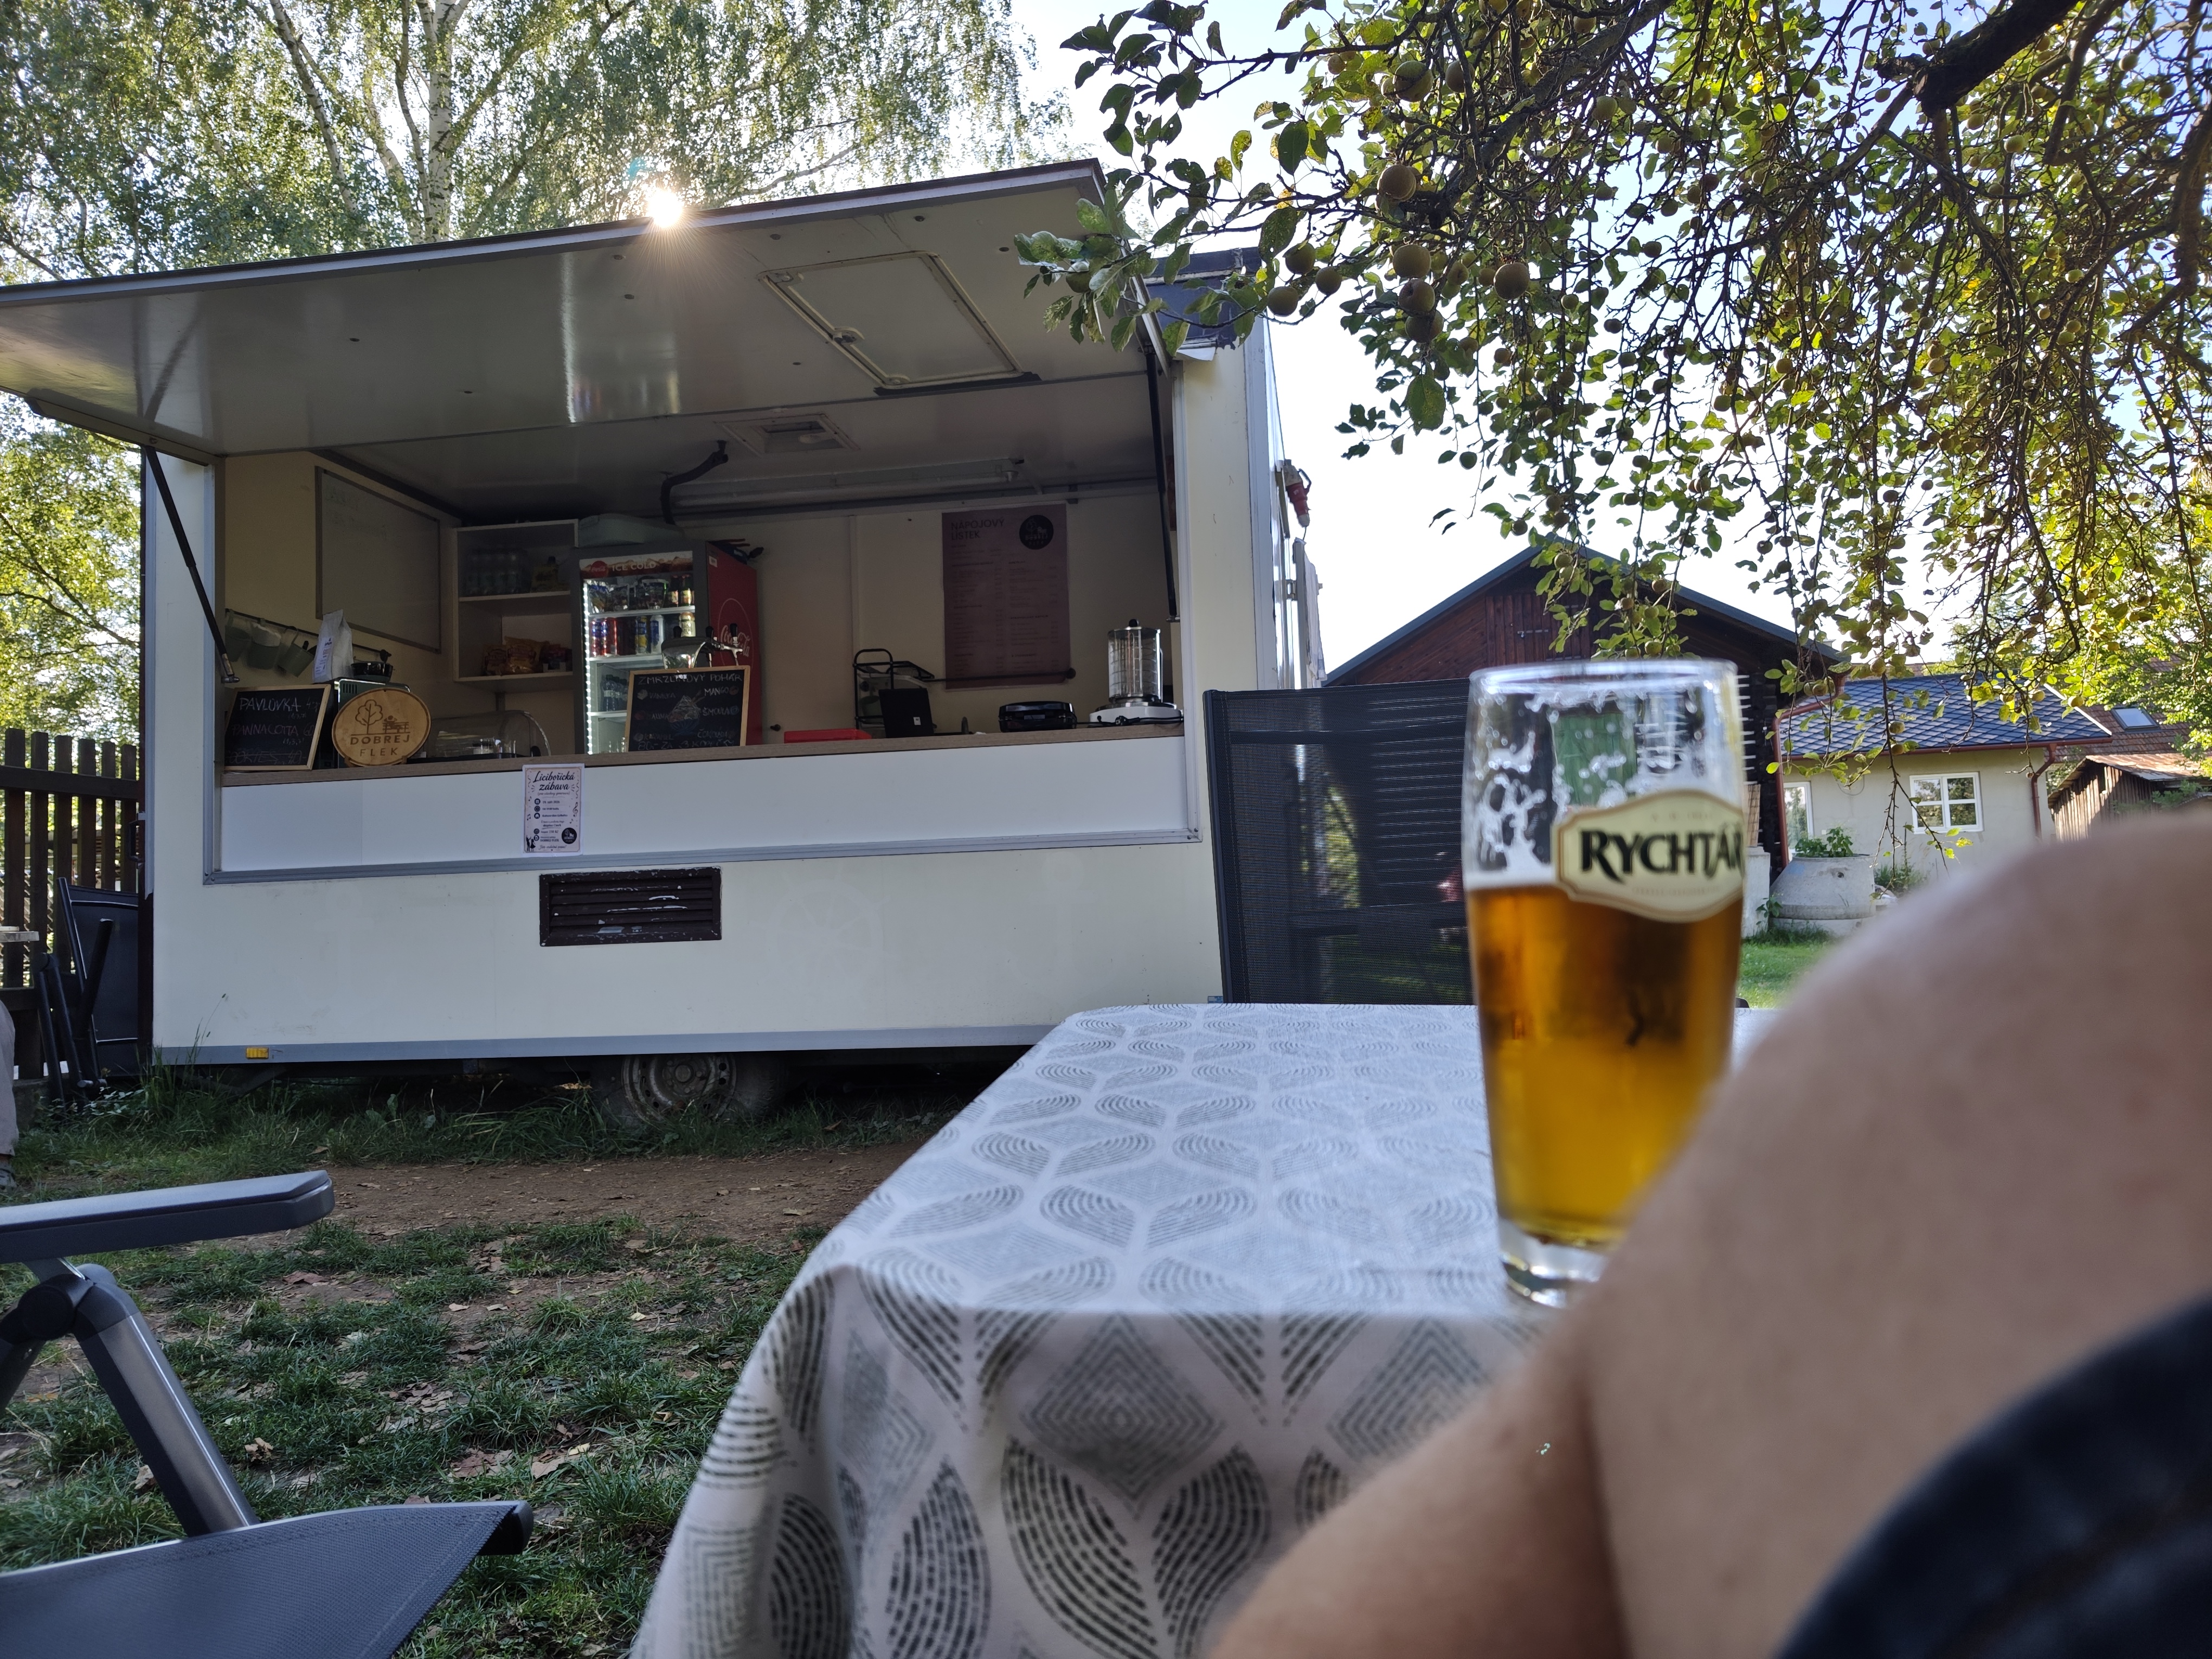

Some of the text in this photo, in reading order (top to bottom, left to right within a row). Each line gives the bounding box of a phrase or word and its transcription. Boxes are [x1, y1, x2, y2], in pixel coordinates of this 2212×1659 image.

[951, 517, 1004, 530] NÁPOJOVÝ
[631, 562, 657, 570] COLD
[703, 686, 729, 696] MANGO
[240, 697, 301, 712] PAVLOVKA
[233, 724, 299, 736] PANNACOTTA
[350, 735, 410, 745] DOBREJ
[360, 747, 398, 757] FLEK
[533, 770, 575, 783] Licibořická
[539, 781, 570, 790] zábava
